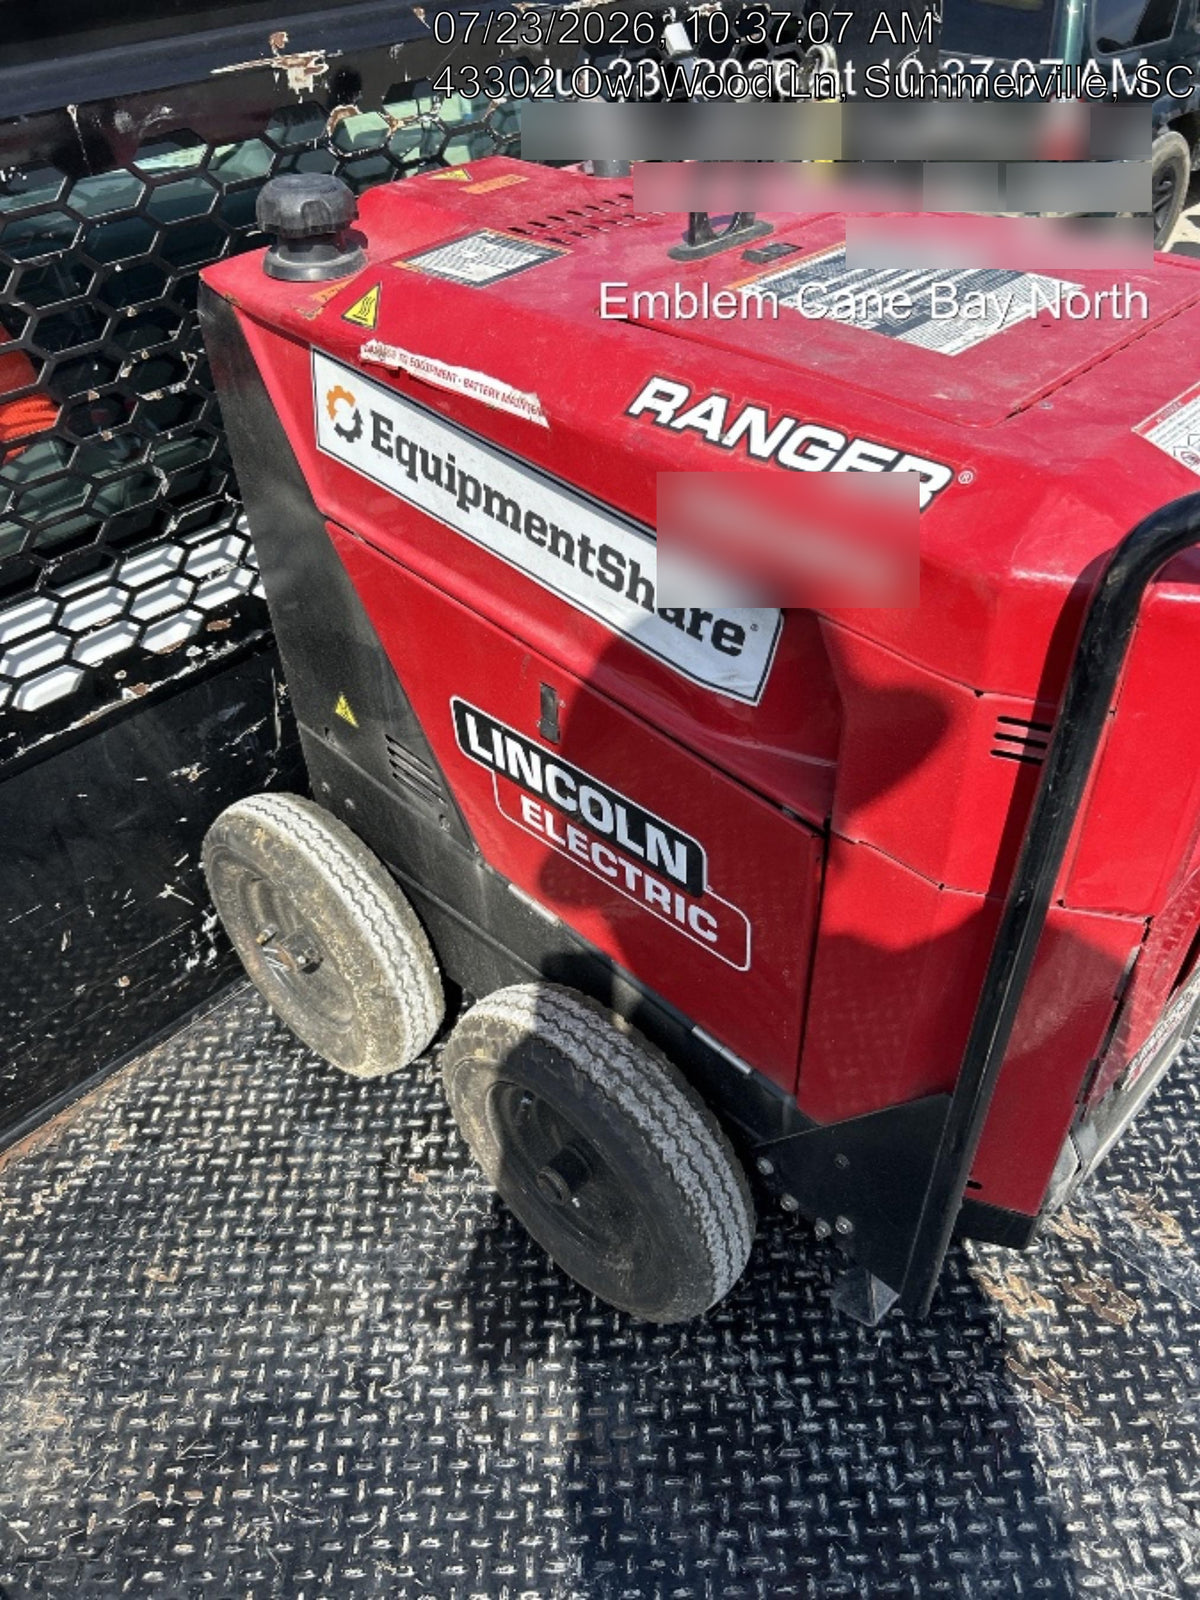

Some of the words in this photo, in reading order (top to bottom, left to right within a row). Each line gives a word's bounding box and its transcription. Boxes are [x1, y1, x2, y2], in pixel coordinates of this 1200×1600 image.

[410, 356, 457, 384] EQUIPMENT
[463, 377, 500, 400] BATTERY
[466, 712, 688, 885] LINCOLN
[520, 794, 718, 943] ELECTRIC
